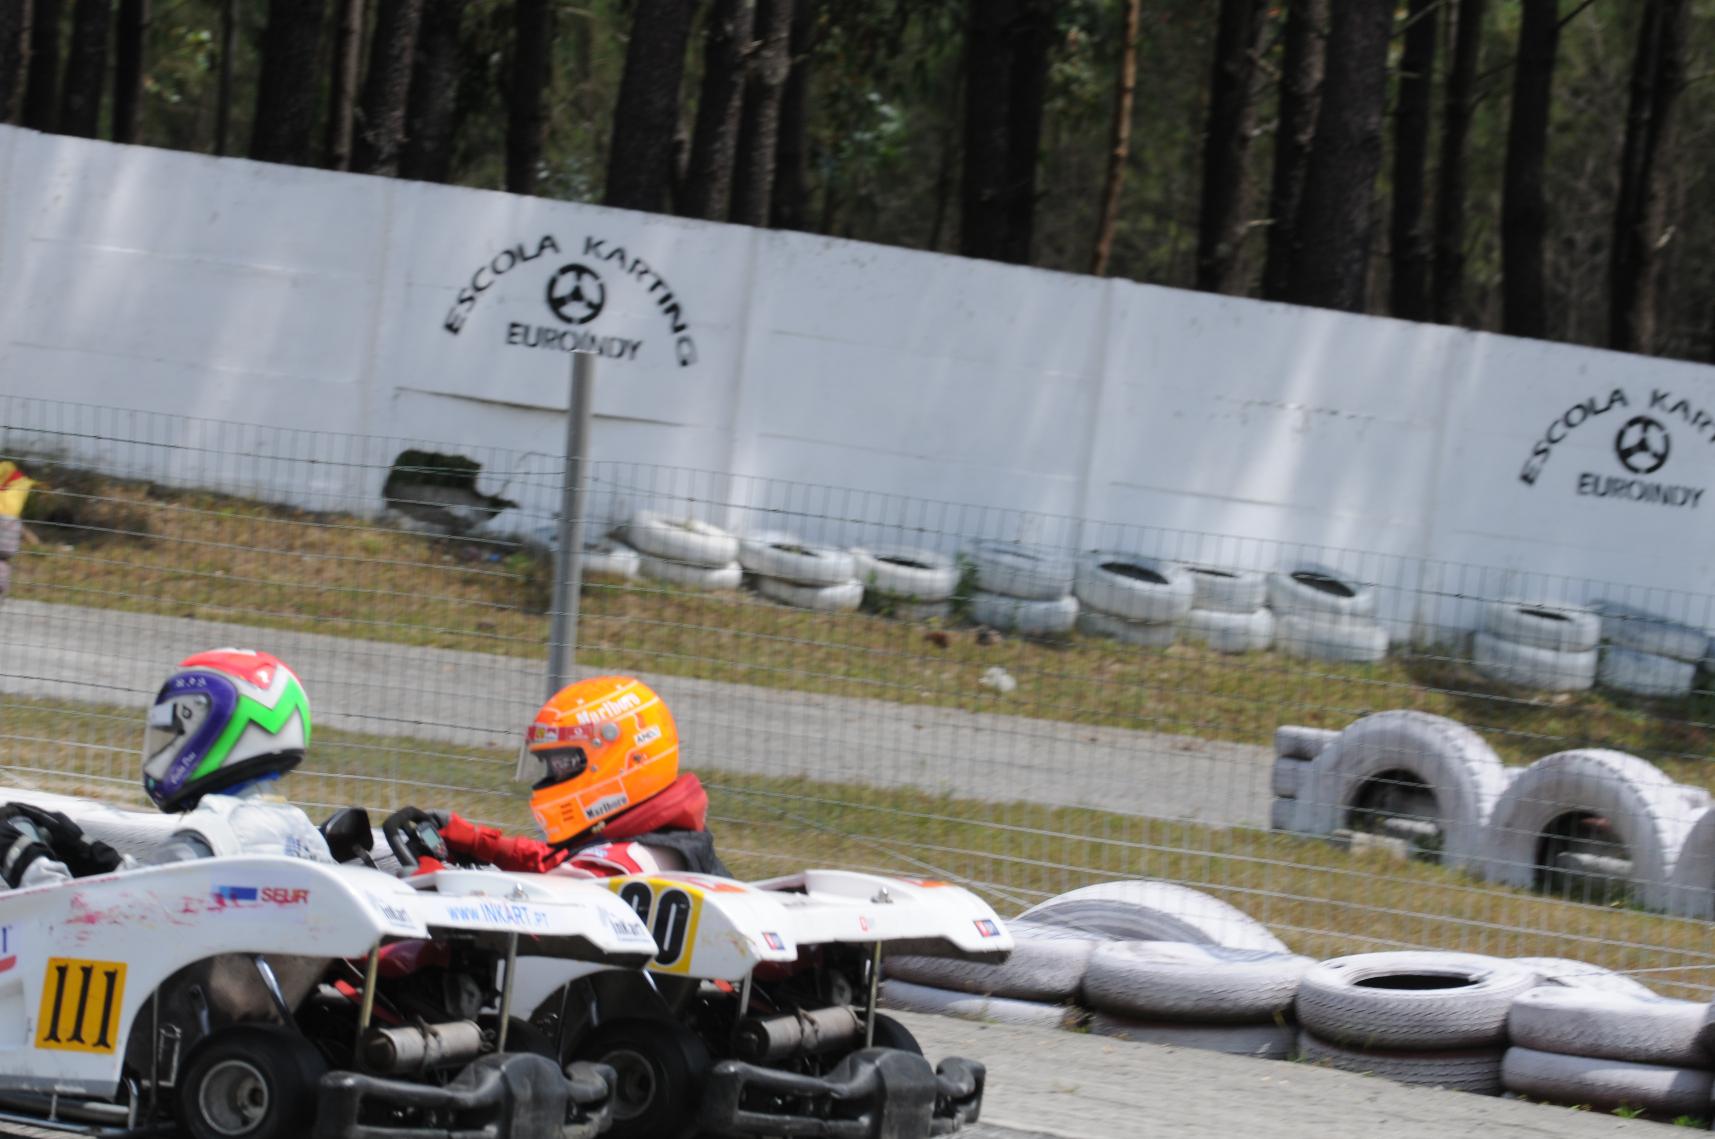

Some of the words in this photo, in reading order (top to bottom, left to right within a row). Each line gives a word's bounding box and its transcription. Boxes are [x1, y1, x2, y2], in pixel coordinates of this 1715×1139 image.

[443, 234, 561, 336] ESCOLA
[583, 236, 698, 368] KARTING
[506, 322, 643, 361] EUROINDY
[1520, 388, 1629, 486] ESCOLA
[1577, 472, 1704, 508] EUROINDY
[575, 692, 641, 725] Marlboro
[261, 887, 310, 903] SEUR
[43, 963, 119, 1050] 111
